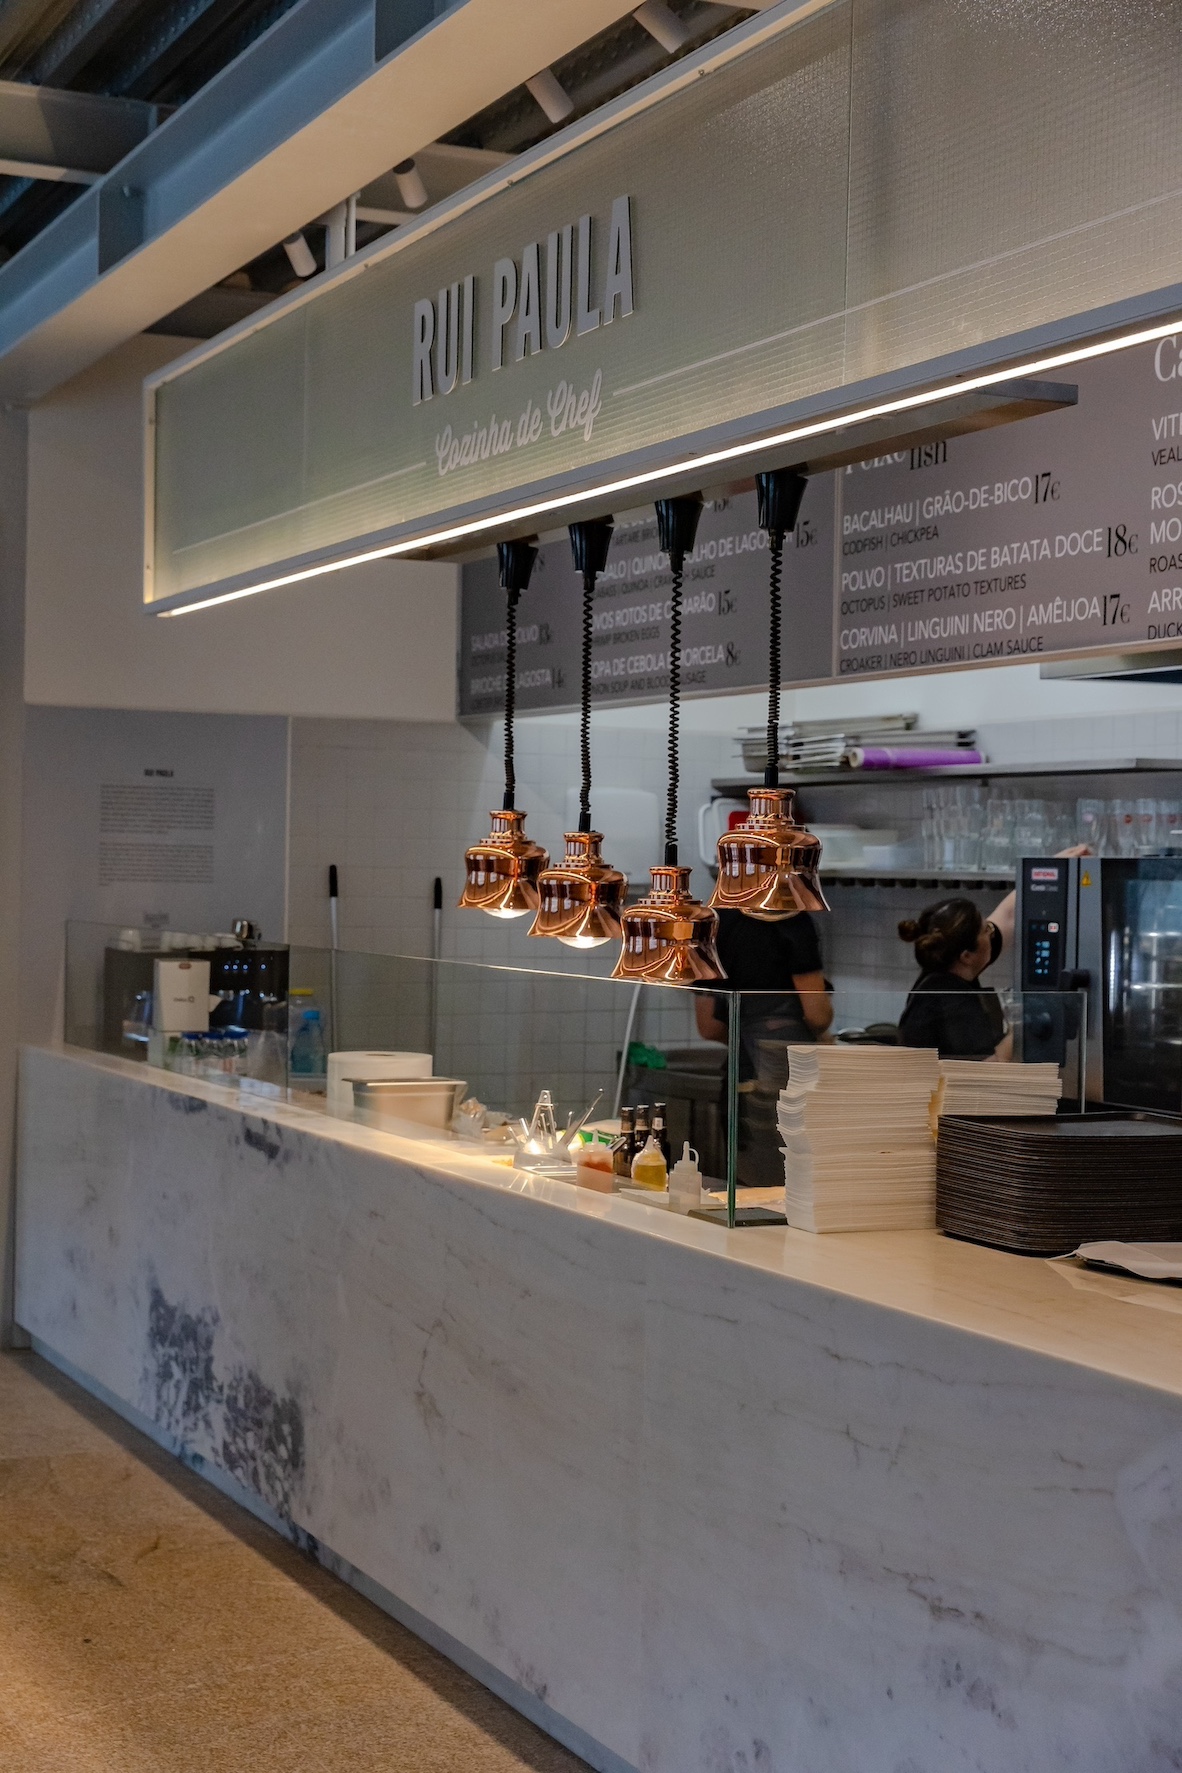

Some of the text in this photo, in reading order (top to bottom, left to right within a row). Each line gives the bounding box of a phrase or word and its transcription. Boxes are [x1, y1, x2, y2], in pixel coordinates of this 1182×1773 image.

[413, 193, 635, 407] RUI PAULA
[435, 367, 603, 477] Cozinha de Chef
[842, 501, 914, 535] BACALHAU
[922, 476, 1033, 519] GRÃO-DE-BICO
[718, 536, 734, 558] DE
[889, 525, 940, 548] CHICKPEA
[841, 565, 886, 592] POLVO
[893, 552, 964, 584] TEXTURAS
[966, 548, 988, 573] DE
[990, 538, 1052, 569] BATATA
[1055, 528, 1104, 558] DOCE
[648, 601, 663, 622] DE
[841, 572, 1028, 616] OCTOPUS SWEET POTATO TEXTURES
[840, 623, 899, 651] CORVINA
[907, 613, 970, 642] LINGUINI
[973, 606, 1017, 634] NERO
[1026, 596, 1102, 627] AMÊIJOA
[626, 652, 666, 674] CEBOLA
[840, 654, 883, 673] CROAKER
[889, 650, 918, 668] NERO
[973, 640, 1004, 659] CLAM
[1007, 635, 1044, 655] SAUCE
